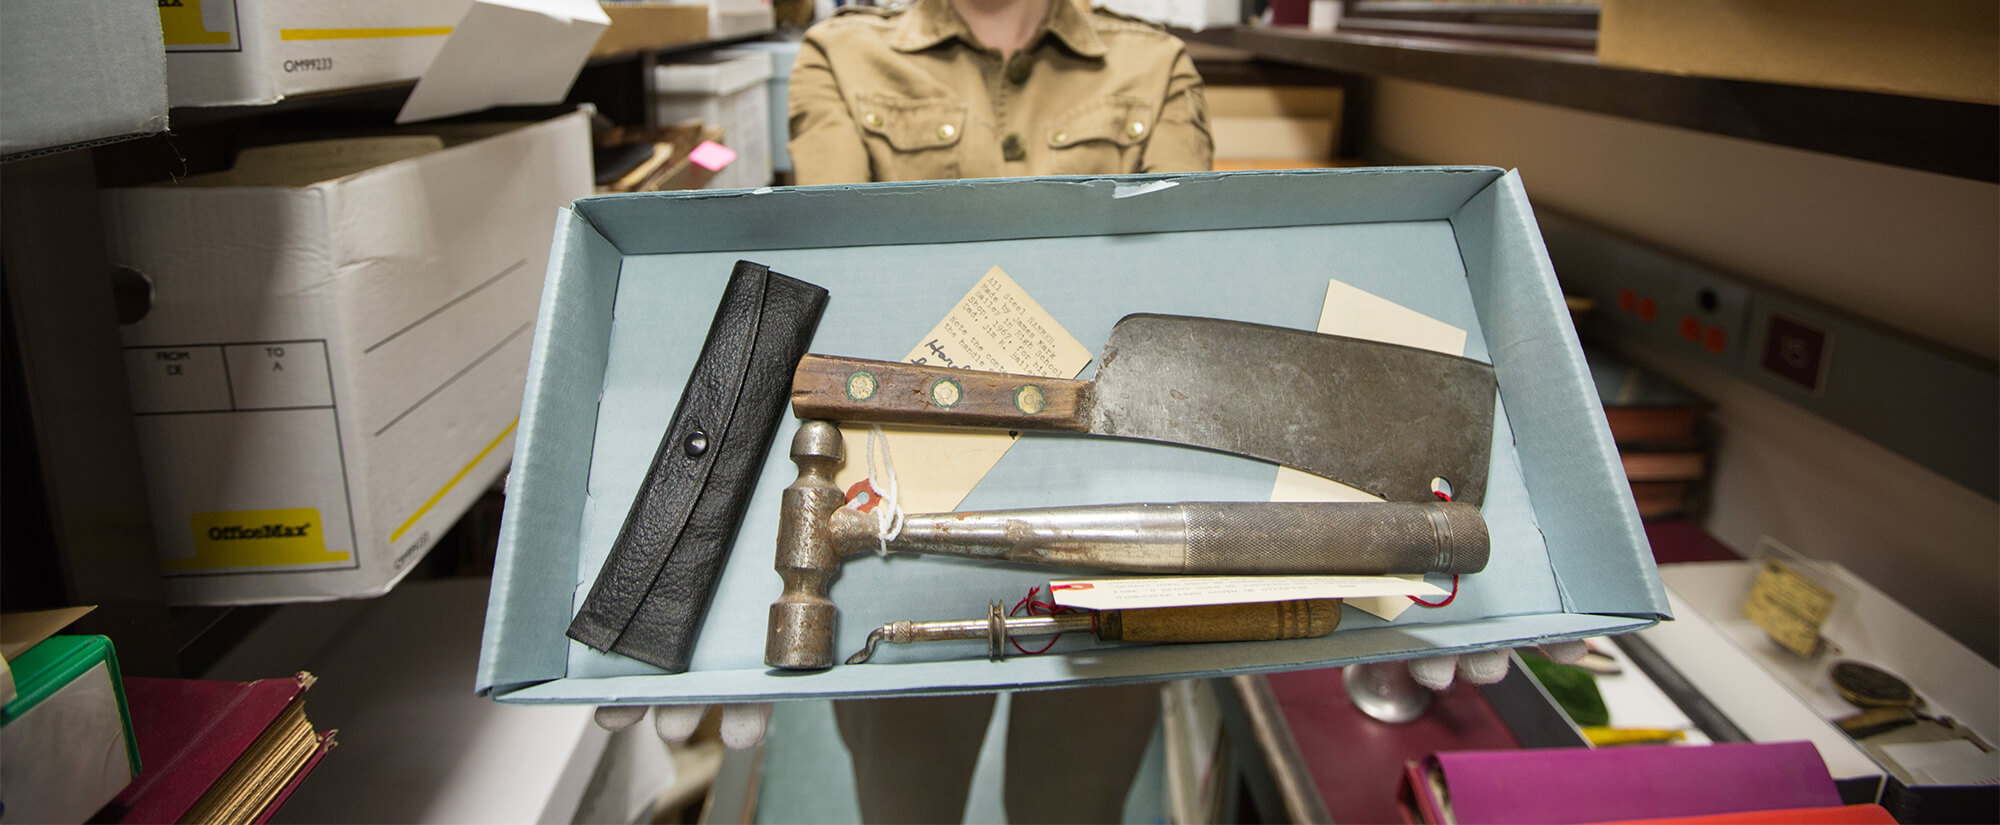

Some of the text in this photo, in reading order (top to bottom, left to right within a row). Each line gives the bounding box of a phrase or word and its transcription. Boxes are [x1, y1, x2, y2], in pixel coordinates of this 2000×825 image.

[987, 277, 1002, 291] All
[1003, 293, 1026, 316] Steel
[949, 316, 968, 335] Note
[970, 337, 984, 352] the
[974, 290, 1063, 377] Bailey in High School
[980, 283, 1056, 360] Made by James Mark
[982, 325, 997, 339] Jim
[156, 346, 285, 361] FROM TO
[944, 323, 985, 366] the handle
[1016, 346, 1032, 361] for
[272, 362, 283, 372] A
[208, 523, 308, 541] OfficeMax
